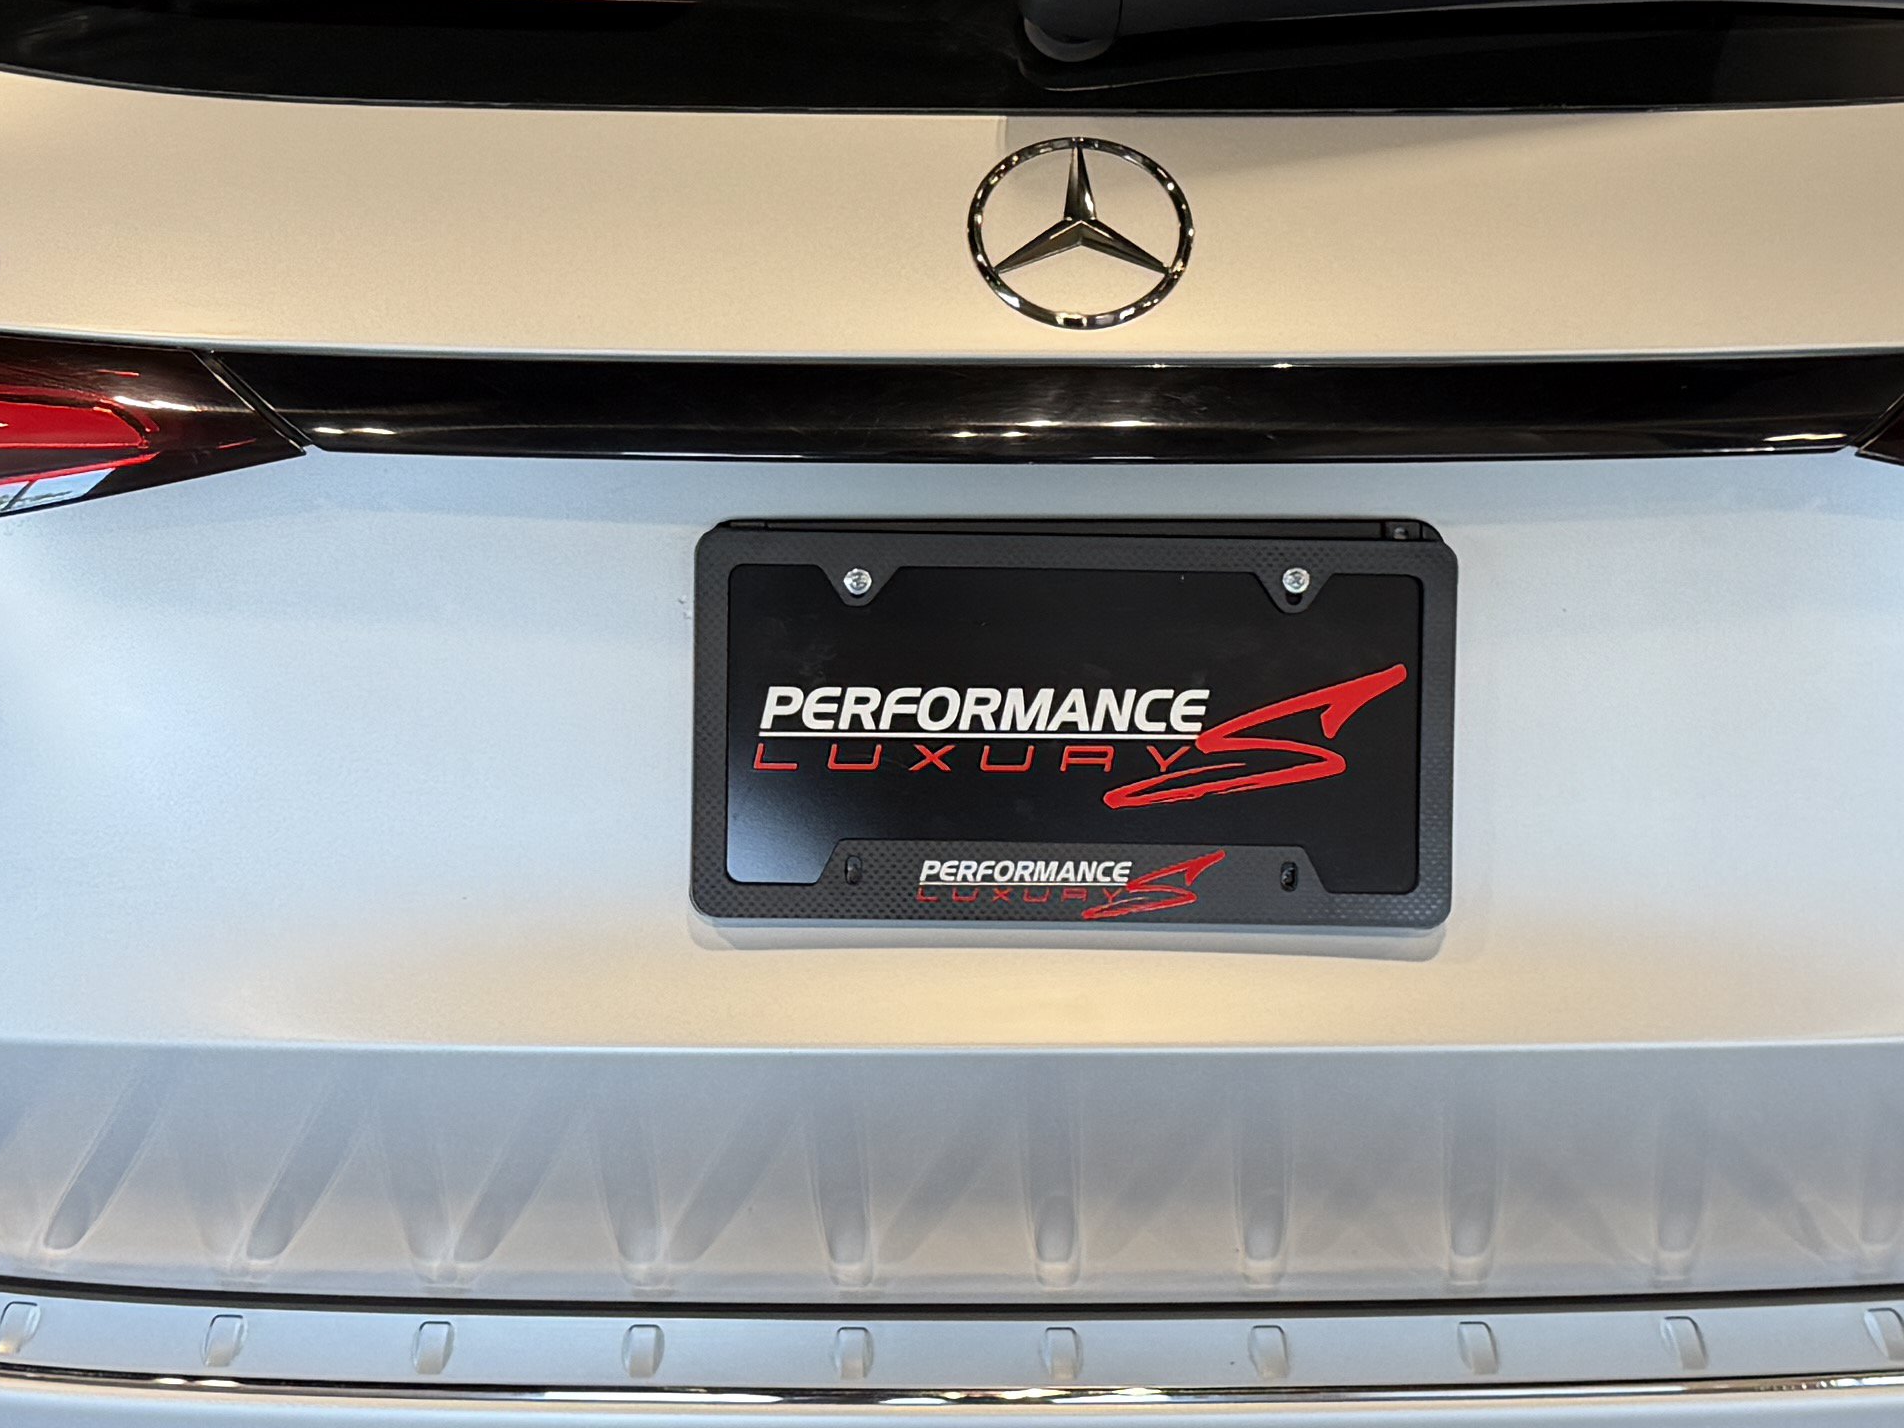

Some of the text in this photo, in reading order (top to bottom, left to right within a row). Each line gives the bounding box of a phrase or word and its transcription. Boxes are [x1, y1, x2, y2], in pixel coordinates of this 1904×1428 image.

[758, 685, 1211, 733] PERFORMANCE
[752, 742, 1193, 772] LUXURY
[918, 859, 1133, 883] PERFORMANCE
[915, 886, 1123, 903] LUXURY
